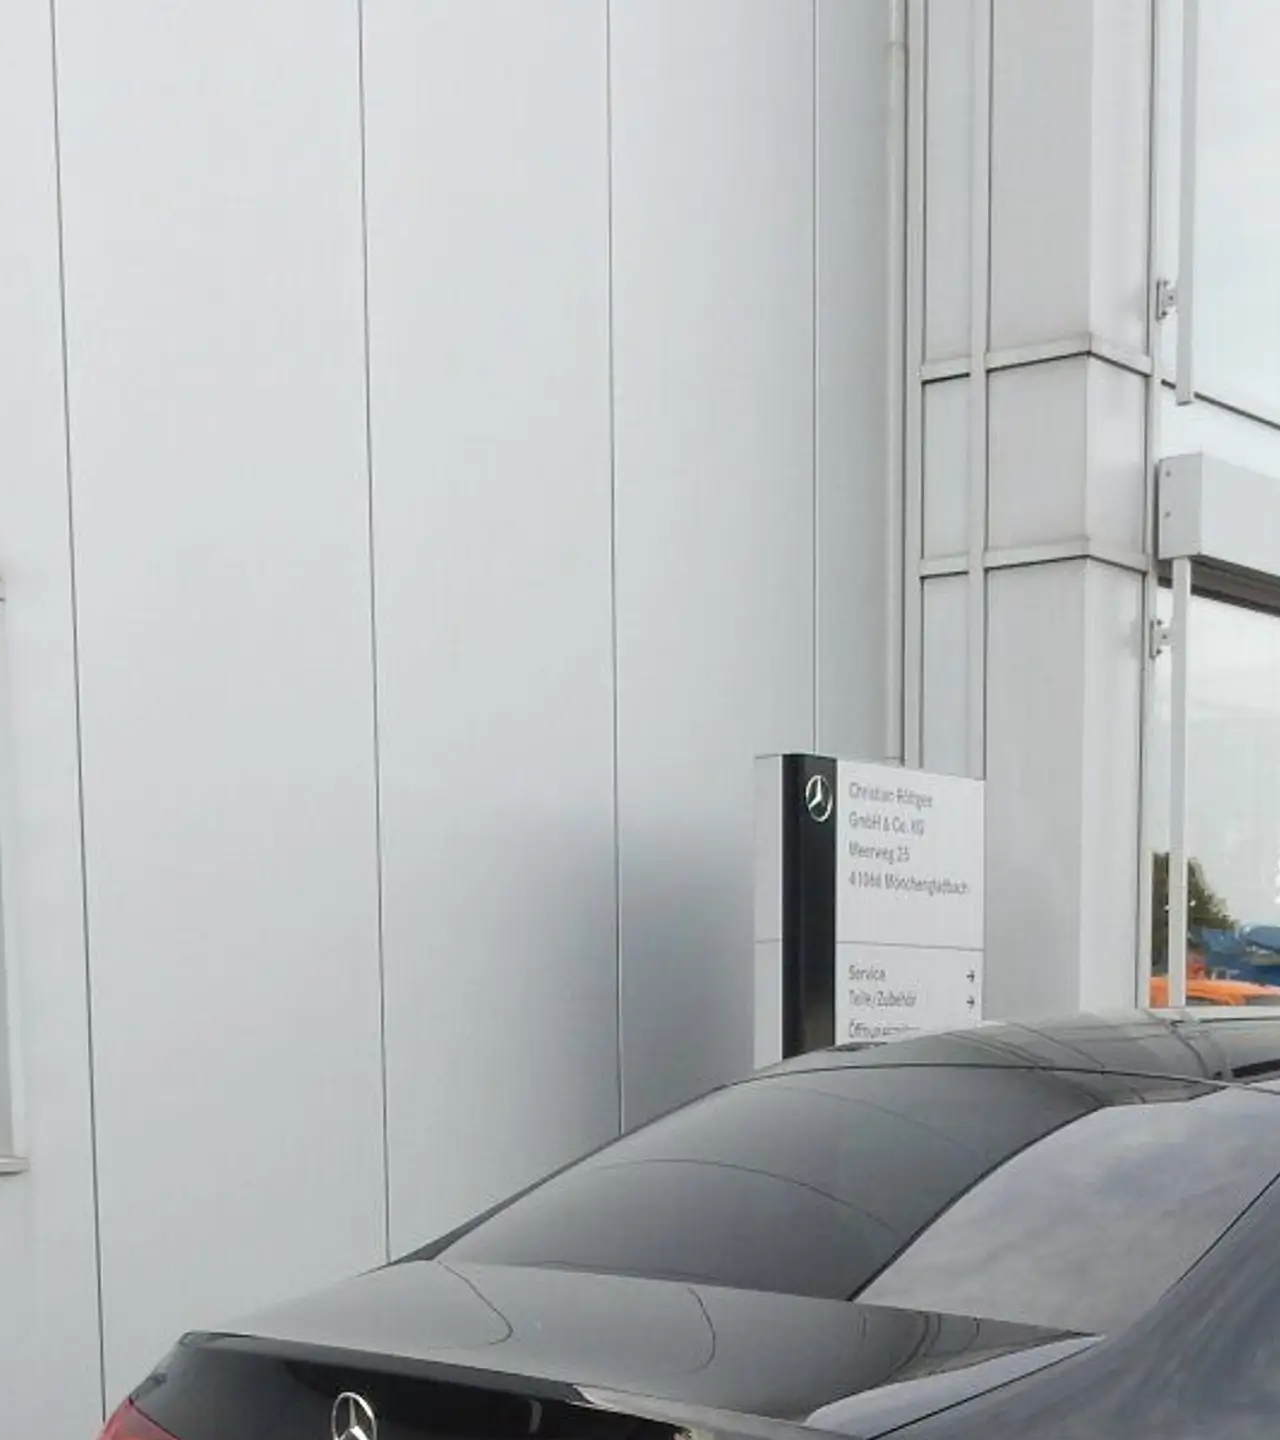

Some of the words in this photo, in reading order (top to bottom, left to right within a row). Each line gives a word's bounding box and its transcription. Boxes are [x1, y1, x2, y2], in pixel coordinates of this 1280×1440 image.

[849, 782, 894, 802] Christian
[848, 811, 881, 831] GmbH
[911, 819, 925, 836] KG
[884, 873, 969, 897] Mönchengladbach
[848, 964, 887, 982] Service
